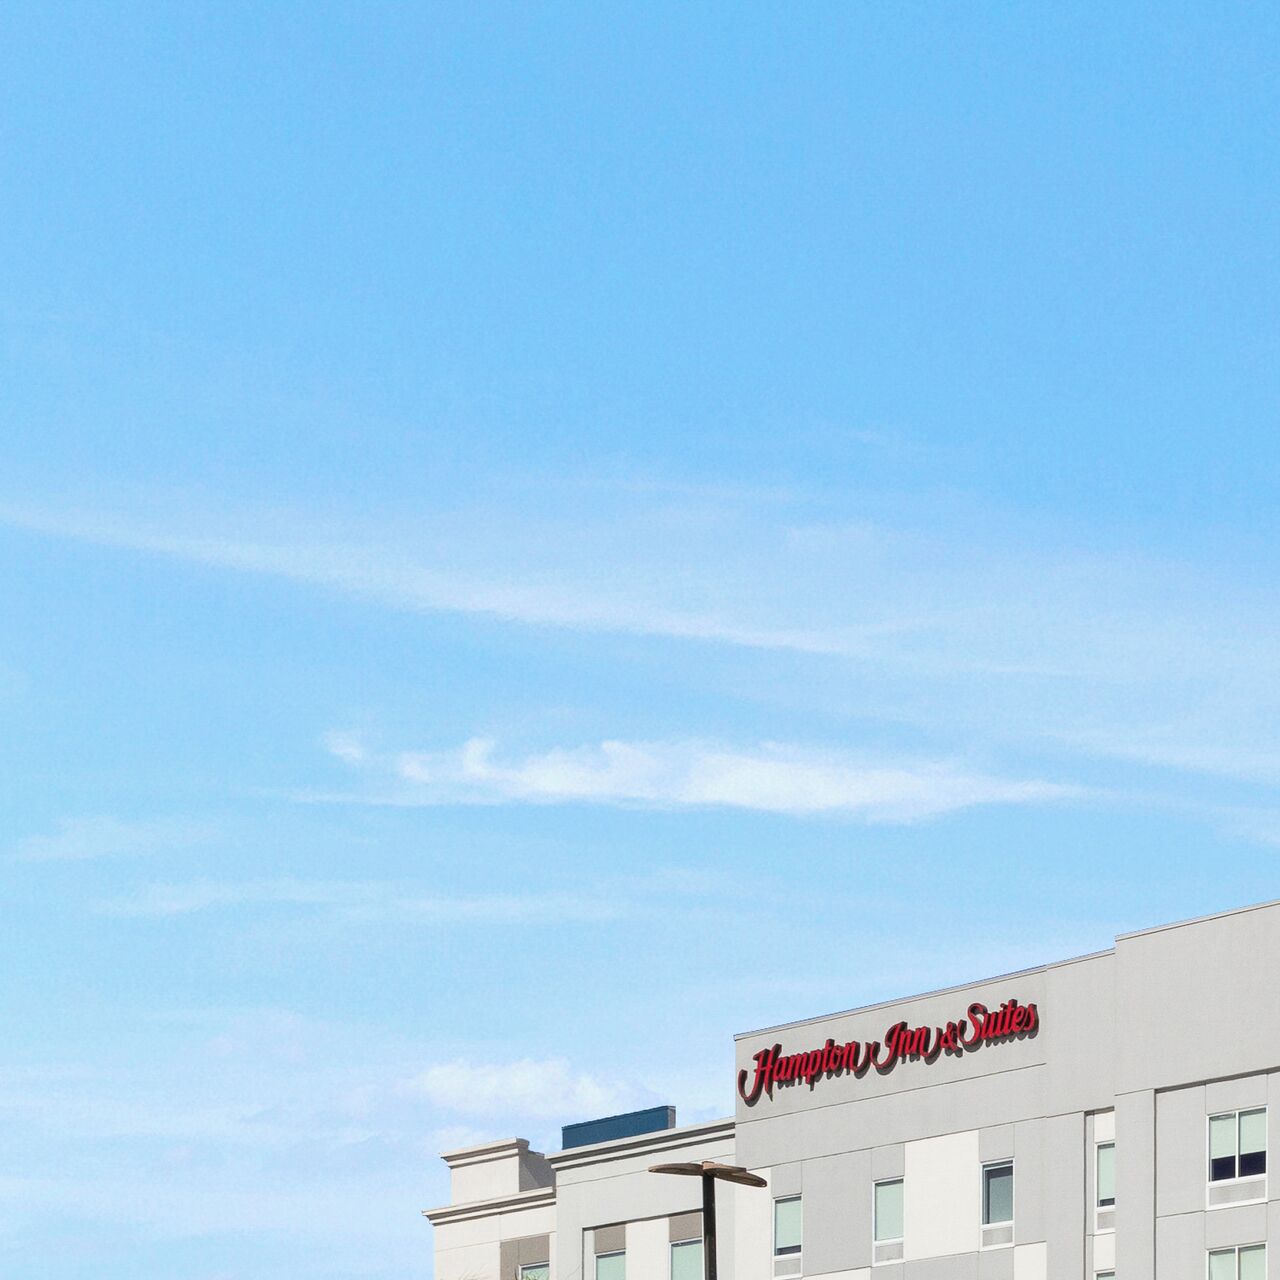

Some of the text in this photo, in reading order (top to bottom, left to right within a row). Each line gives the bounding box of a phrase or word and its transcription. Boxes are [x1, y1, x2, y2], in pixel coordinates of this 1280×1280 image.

[738, 999, 1038, 1104] Hampton Inn & Suites
